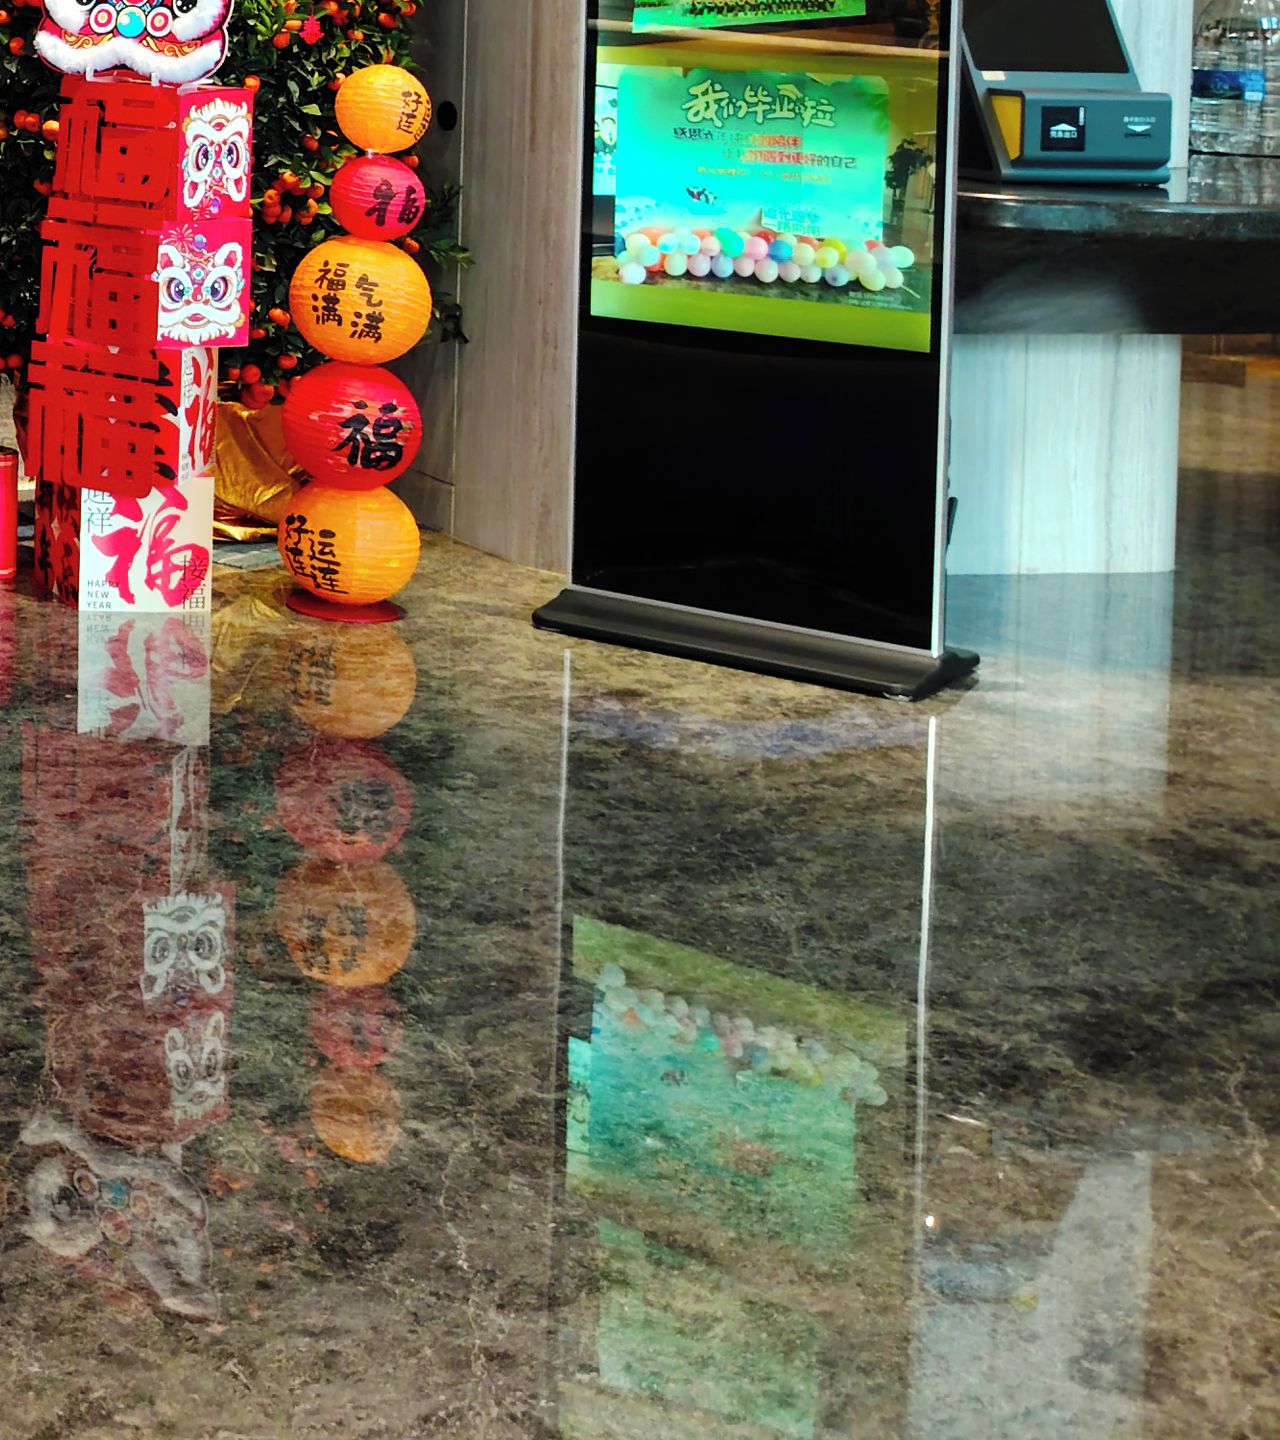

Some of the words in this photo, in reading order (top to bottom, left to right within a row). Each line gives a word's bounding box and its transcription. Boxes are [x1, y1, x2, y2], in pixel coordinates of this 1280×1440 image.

[682, 80, 836, 127] 我们毕业啦
[366, 179, 420, 227] 福
[332, 400, 404, 472] 福
[91, 486, 210, 608] 福
[87, 580, 120, 588] HAPPY
[87, 591, 109, 599] NEW
[181, 555, 207, 609] 接福
